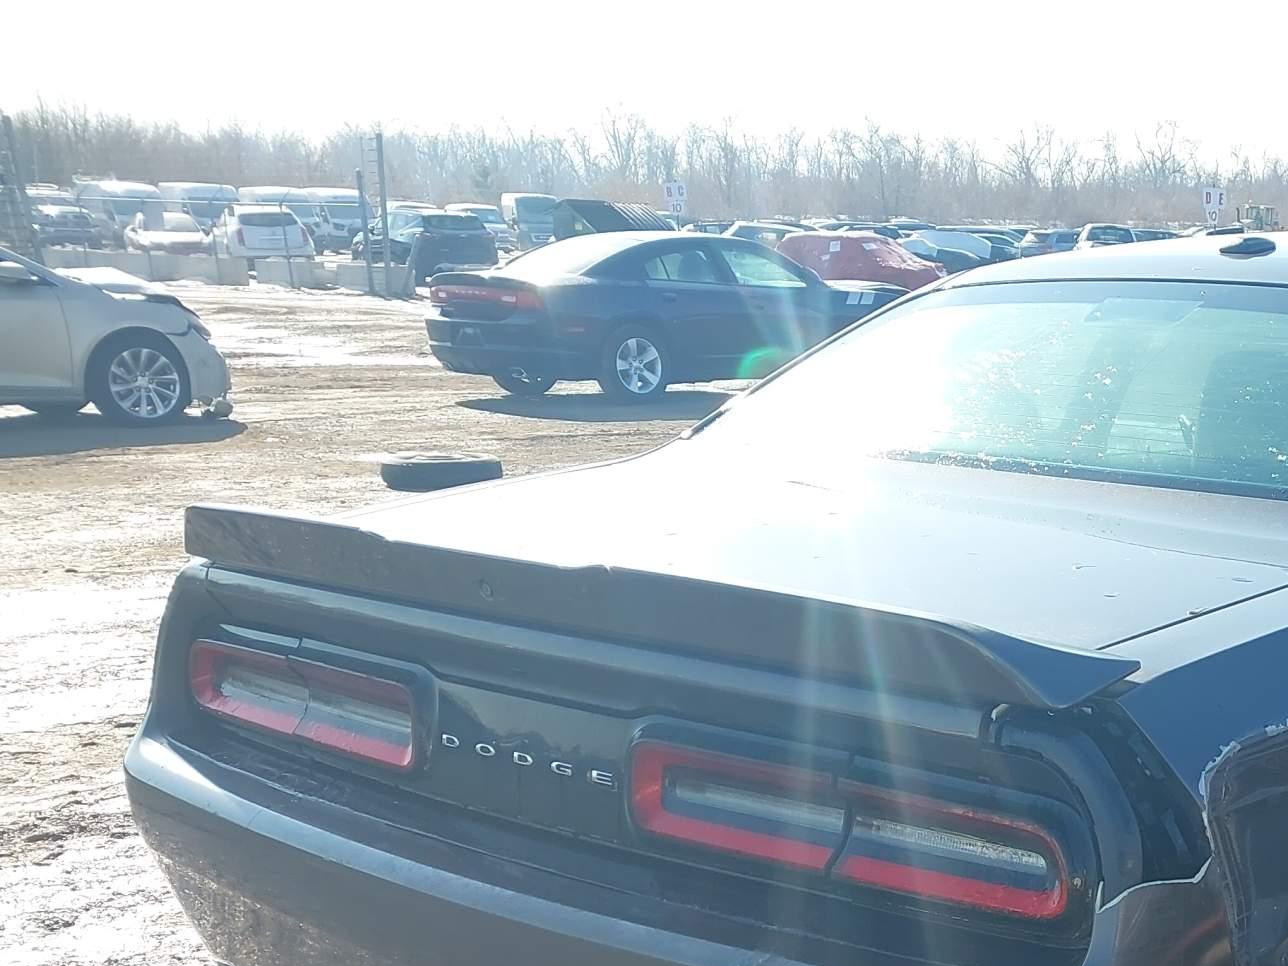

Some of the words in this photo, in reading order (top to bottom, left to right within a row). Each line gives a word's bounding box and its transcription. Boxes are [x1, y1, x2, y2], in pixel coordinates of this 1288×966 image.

[678, 185, 684, 196] C
[1205, 191, 1211, 204] D
[1219, 192, 1224, 205] E
[672, 203, 682, 213] 10
[441, 733, 613, 786] DODGE
